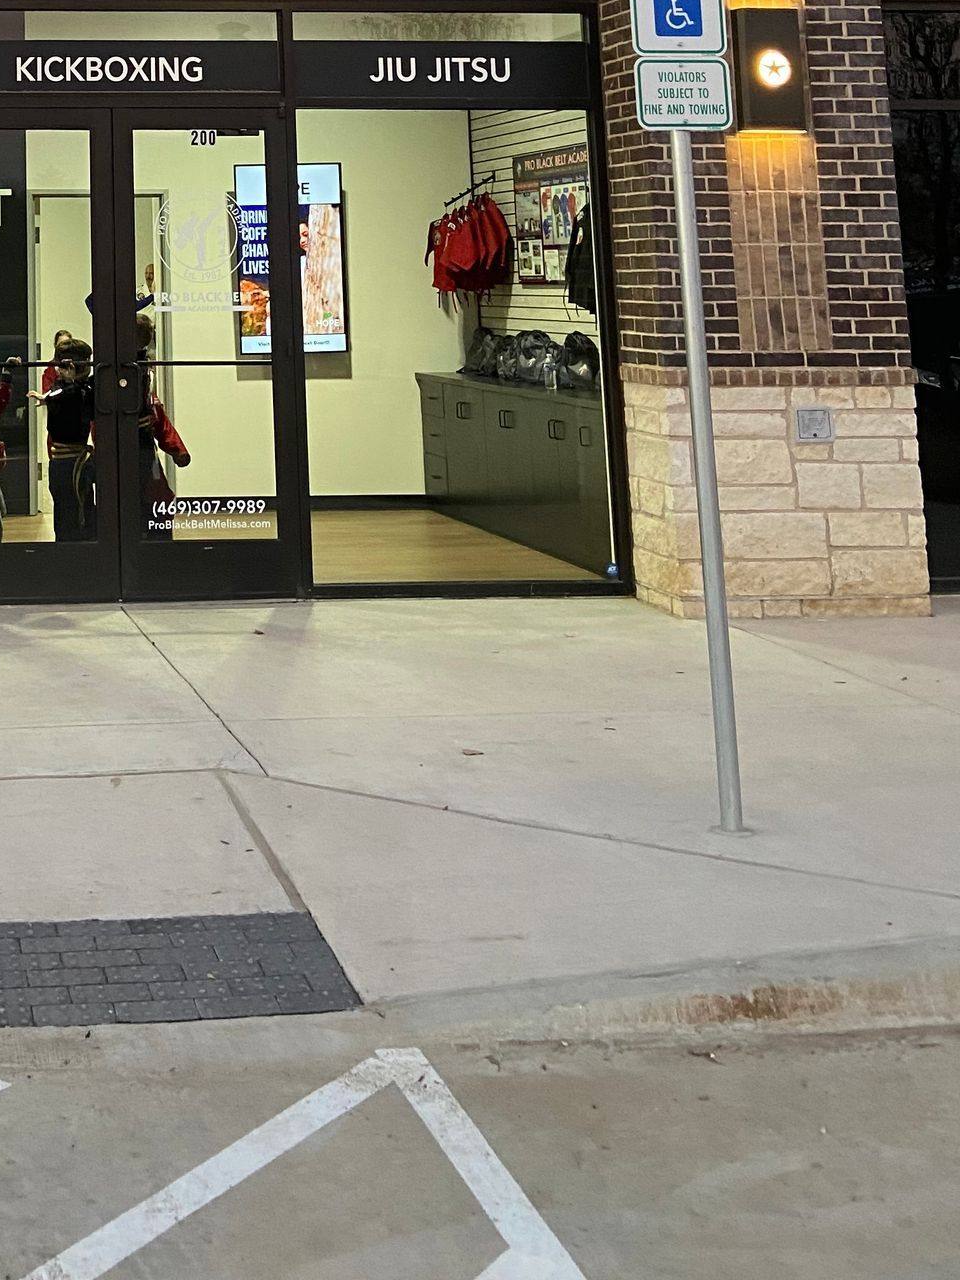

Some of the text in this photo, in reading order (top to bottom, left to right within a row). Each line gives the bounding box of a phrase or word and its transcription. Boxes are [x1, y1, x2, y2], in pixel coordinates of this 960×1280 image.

[16, 56, 204, 82] KICKBOXING
[369, 57, 511, 83] JIU JITSU
[658, 71, 707, 83] VIOLATORS
[657, 88, 710, 99] SUBJECT TO
[644, 104, 725, 115] FINE AND TOWING
[191, 131, 215, 145] 200
[568, 151, 588, 164] ACADE
[240, 210, 268, 224] DRIN
[241, 226, 268, 241] COFF
[152, 500, 266, 517] (469)307-9989
[148, 519, 271, 530] ProBlackBeltMelissa.com
